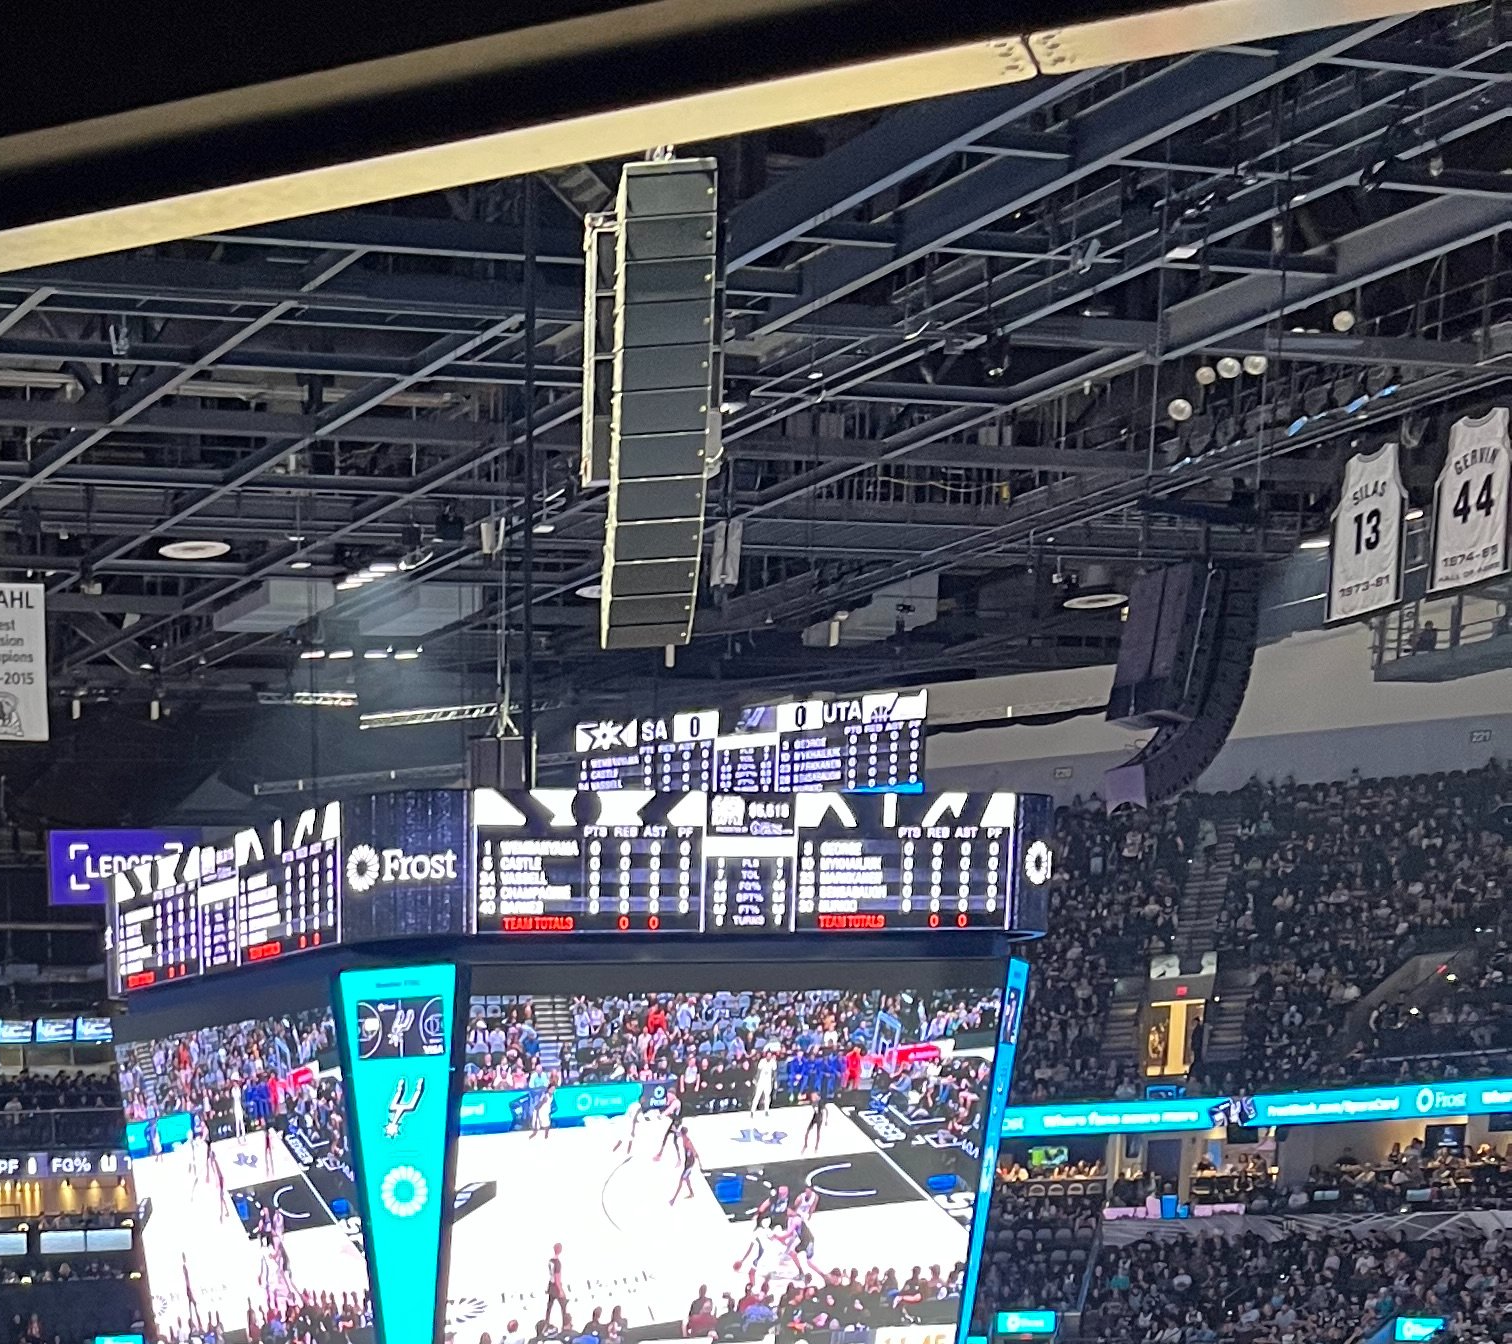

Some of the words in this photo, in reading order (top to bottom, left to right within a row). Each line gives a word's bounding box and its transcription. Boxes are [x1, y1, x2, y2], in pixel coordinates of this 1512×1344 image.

[1454, 446, 1500, 475] GERVIN
[1352, 480, 1387, 506] SILAS
[1452, 472, 1495, 524] 44
[1353, 508, 1381, 555] 13
[795, 705, 806, 728] 0
[824, 700, 862, 723] UTA
[641, 719, 668, 741] SA
[689, 715, 701, 737] 0
[381, 848, 458, 883] Frost
[503, 917, 533, 930] TEAM
[534, 917, 574, 930] TOTALS
[619, 916, 629, 930] 0
[649, 916, 659, 930] 0
[818, 915, 846, 928] TEAM
[847, 915, 886, 928] TOTALS
[929, 915, 939, 928] 0
[958, 915, 967, 928] 0
[1434, 1091, 1467, 1109] Frost
[51, 1157, 92, 1173] FG%
